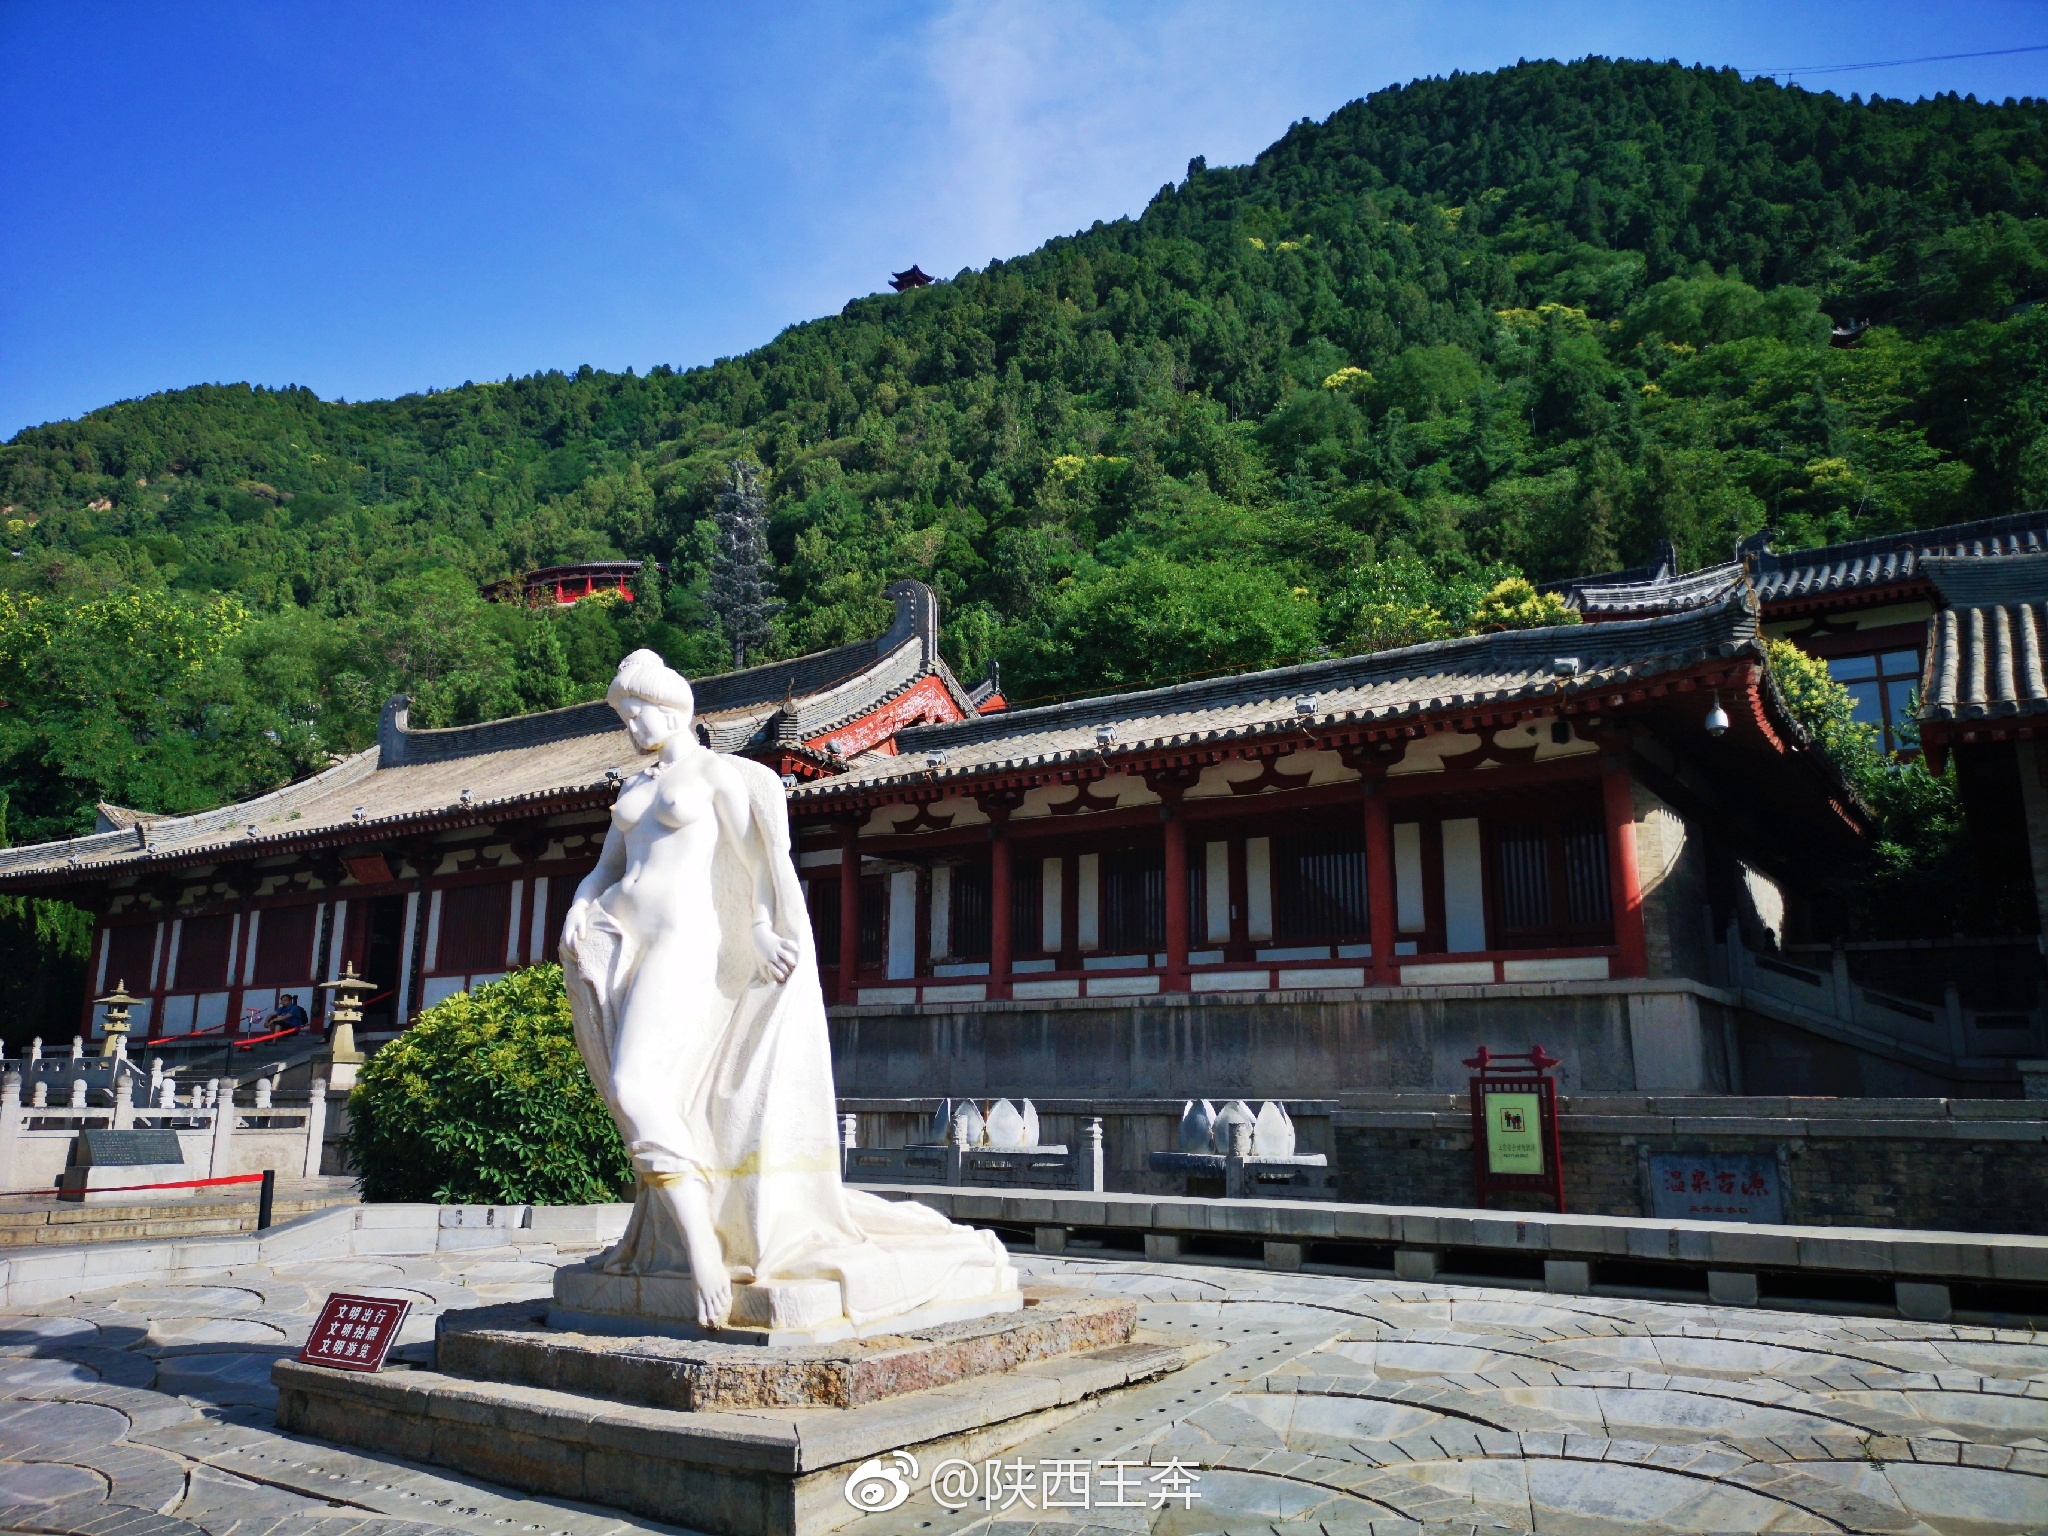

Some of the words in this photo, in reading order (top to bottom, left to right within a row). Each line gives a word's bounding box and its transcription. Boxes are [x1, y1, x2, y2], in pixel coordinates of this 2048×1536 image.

[1663, 1169, 1769, 1197] 温泉古源
[334, 1304, 387, 1324] 文明出行
[326, 1320, 380, 1341] 文明拍照
[318, 1338, 371, 1359] 文明游览
